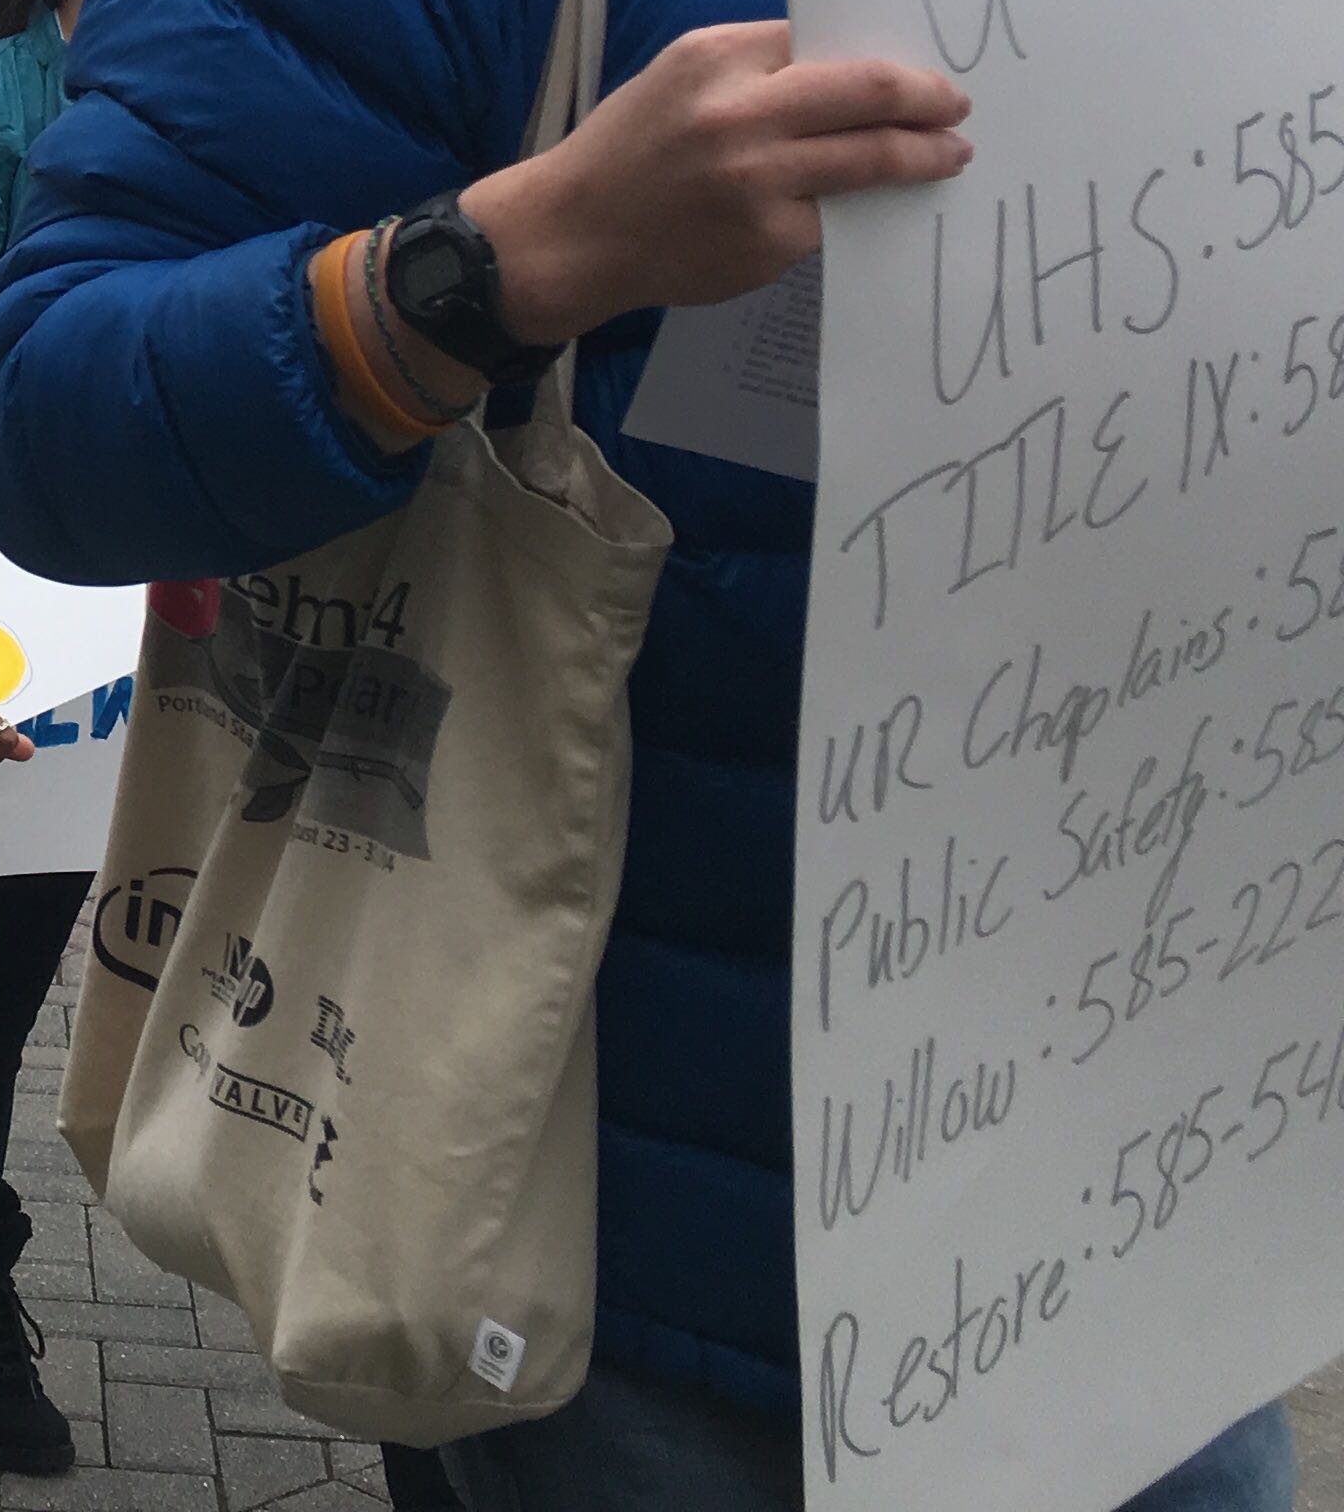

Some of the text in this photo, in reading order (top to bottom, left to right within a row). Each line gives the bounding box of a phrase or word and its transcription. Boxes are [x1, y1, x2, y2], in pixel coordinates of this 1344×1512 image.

[841, 395, 1149, 631] TITLE
[819, 693, 934, 825] UR
[819, 836, 1014, 1032] Public
